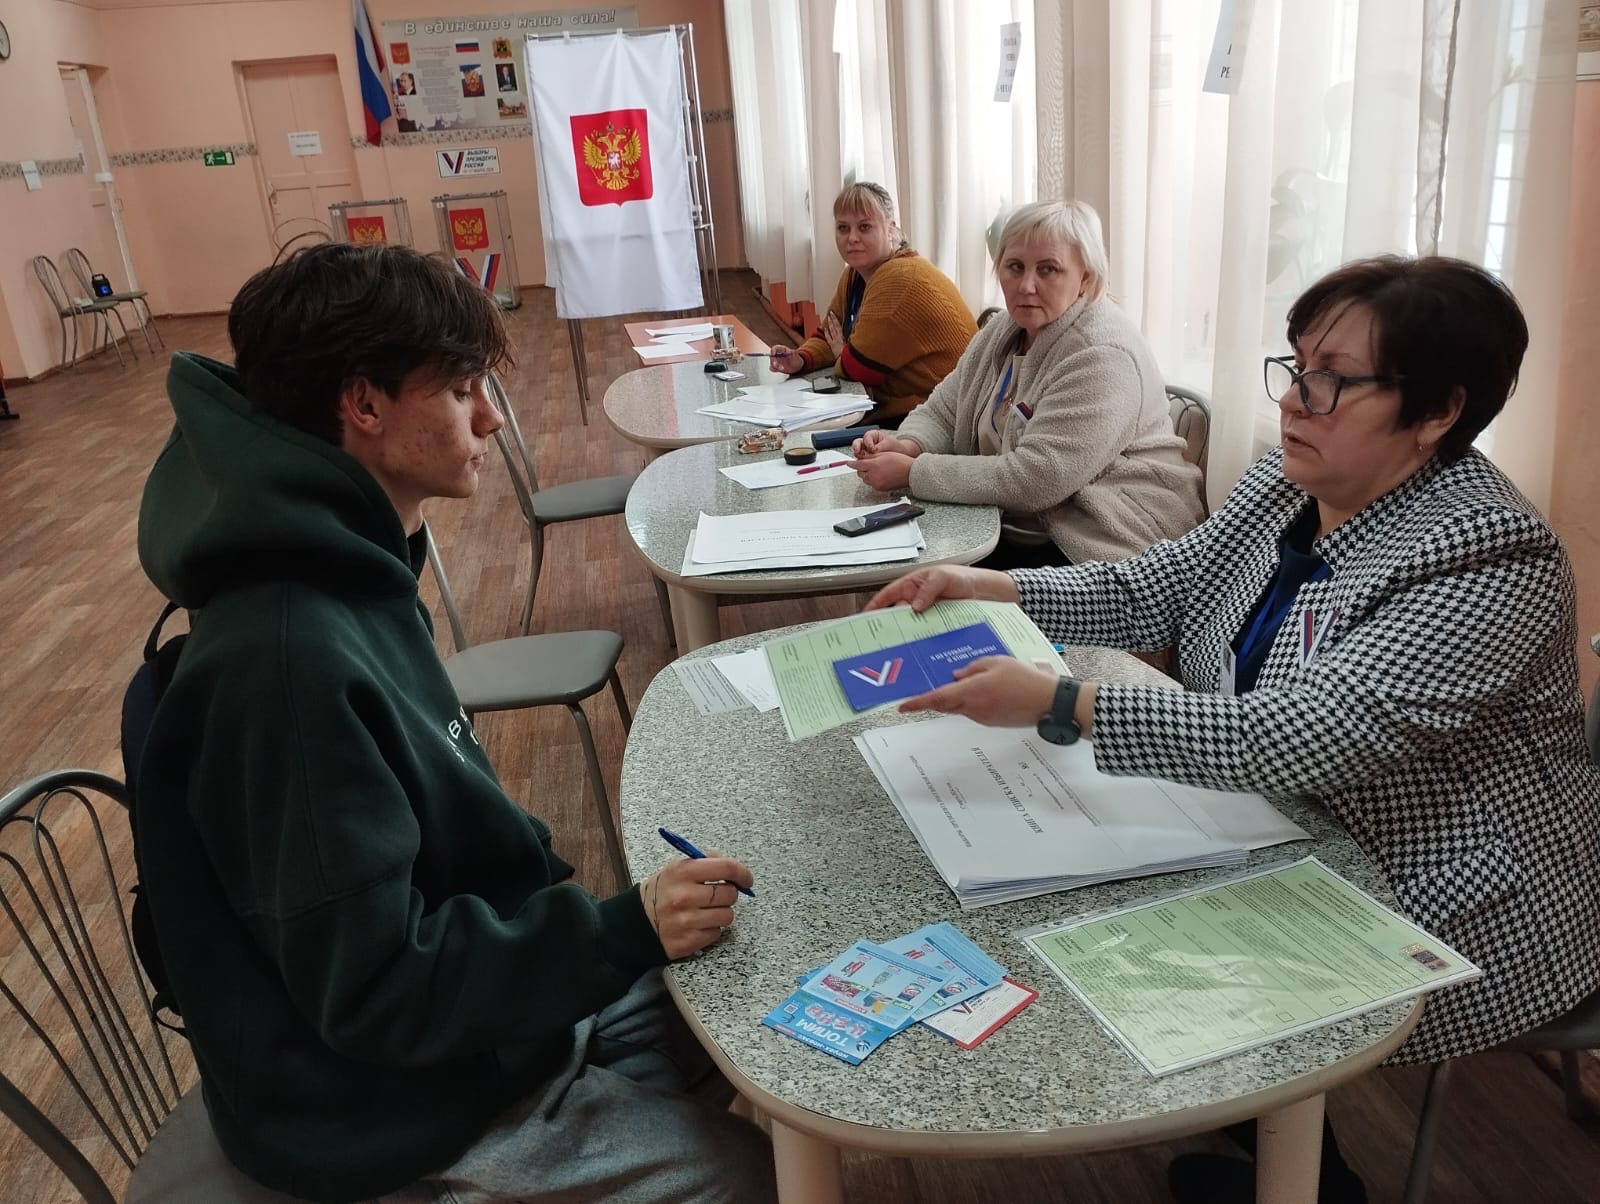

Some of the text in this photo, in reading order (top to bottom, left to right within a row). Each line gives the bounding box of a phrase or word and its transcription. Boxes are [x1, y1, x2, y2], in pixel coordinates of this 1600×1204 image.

[404, 9, 616, 35] В единстве наша сила!
[970, 746, 1006, 785] ИЗБИРАТЕЛЕЙ
[1000, 786, 1027, 811] СПИСКА
[1021, 812, 1044, 833] КНИГА
[795, 1018, 849, 1047] ТОПИМ
